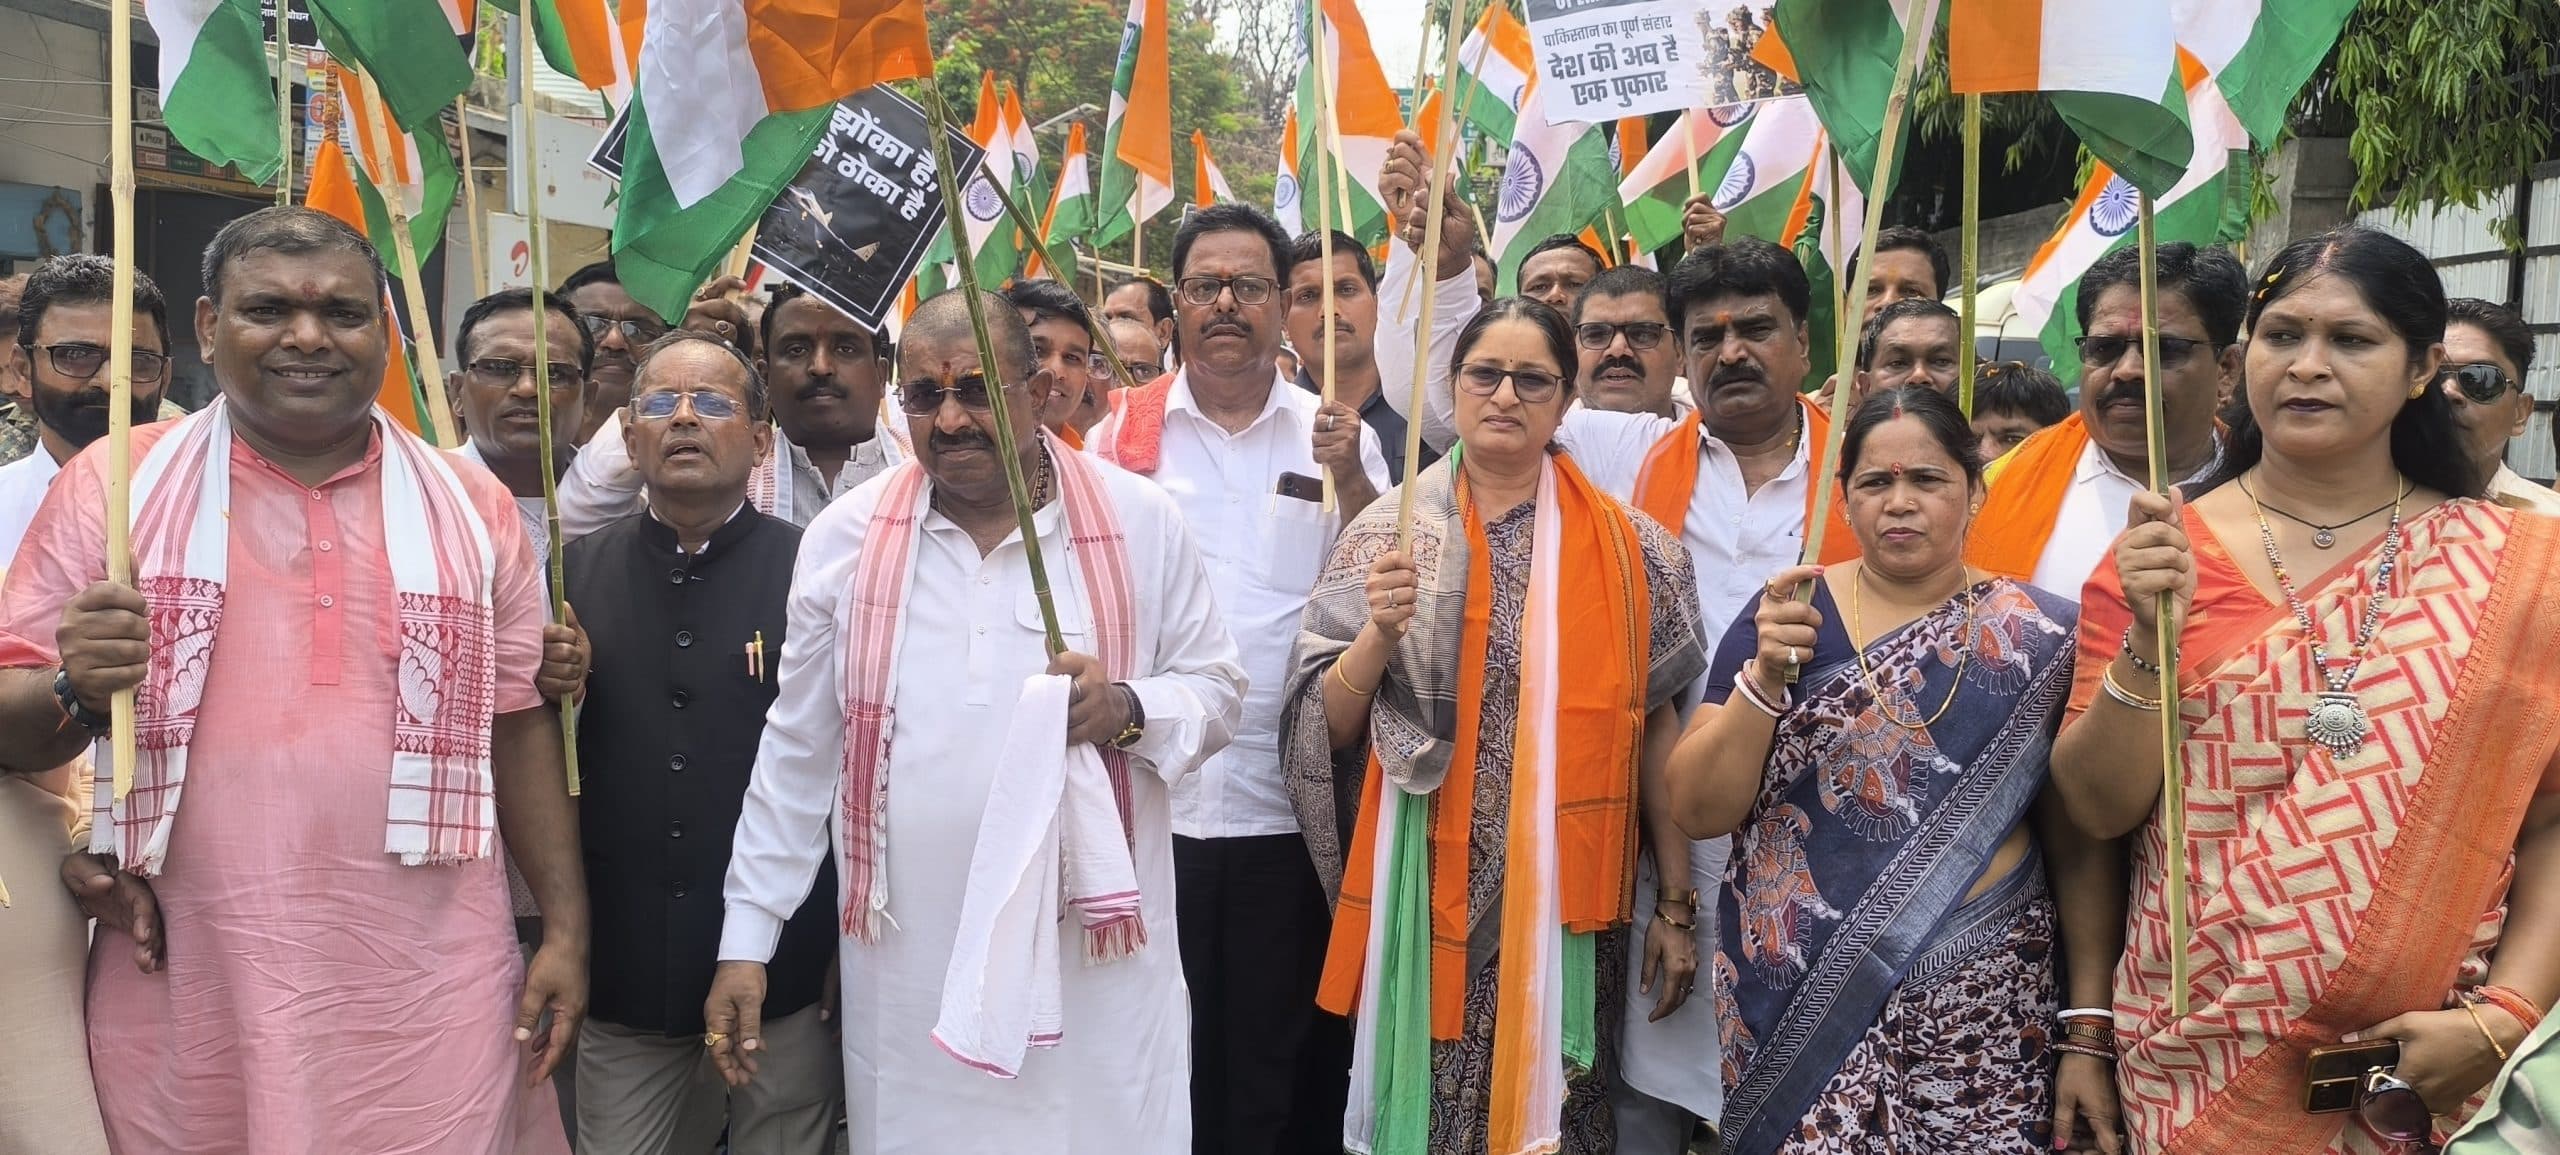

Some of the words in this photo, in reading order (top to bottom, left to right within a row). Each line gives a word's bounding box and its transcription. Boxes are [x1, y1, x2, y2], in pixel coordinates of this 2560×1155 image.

[1544, 25, 1600, 46] पाकिस्तान
[1601, 22, 1617, 36] का
[1620, 17, 1639, 39] पूर्ण
[1641, 14, 1672, 31] संहार
[1548, 53, 1585, 79] देश
[1588, 43, 1618, 72] की
[1622, 43, 1659, 66] अब
[1662, 34, 1679, 62] है
[1571, 79, 1607, 105] एक
[1611, 71, 1668, 108] पुकार
[837, 151, 904, 205] ठोका
[900, 187, 926, 222] है
